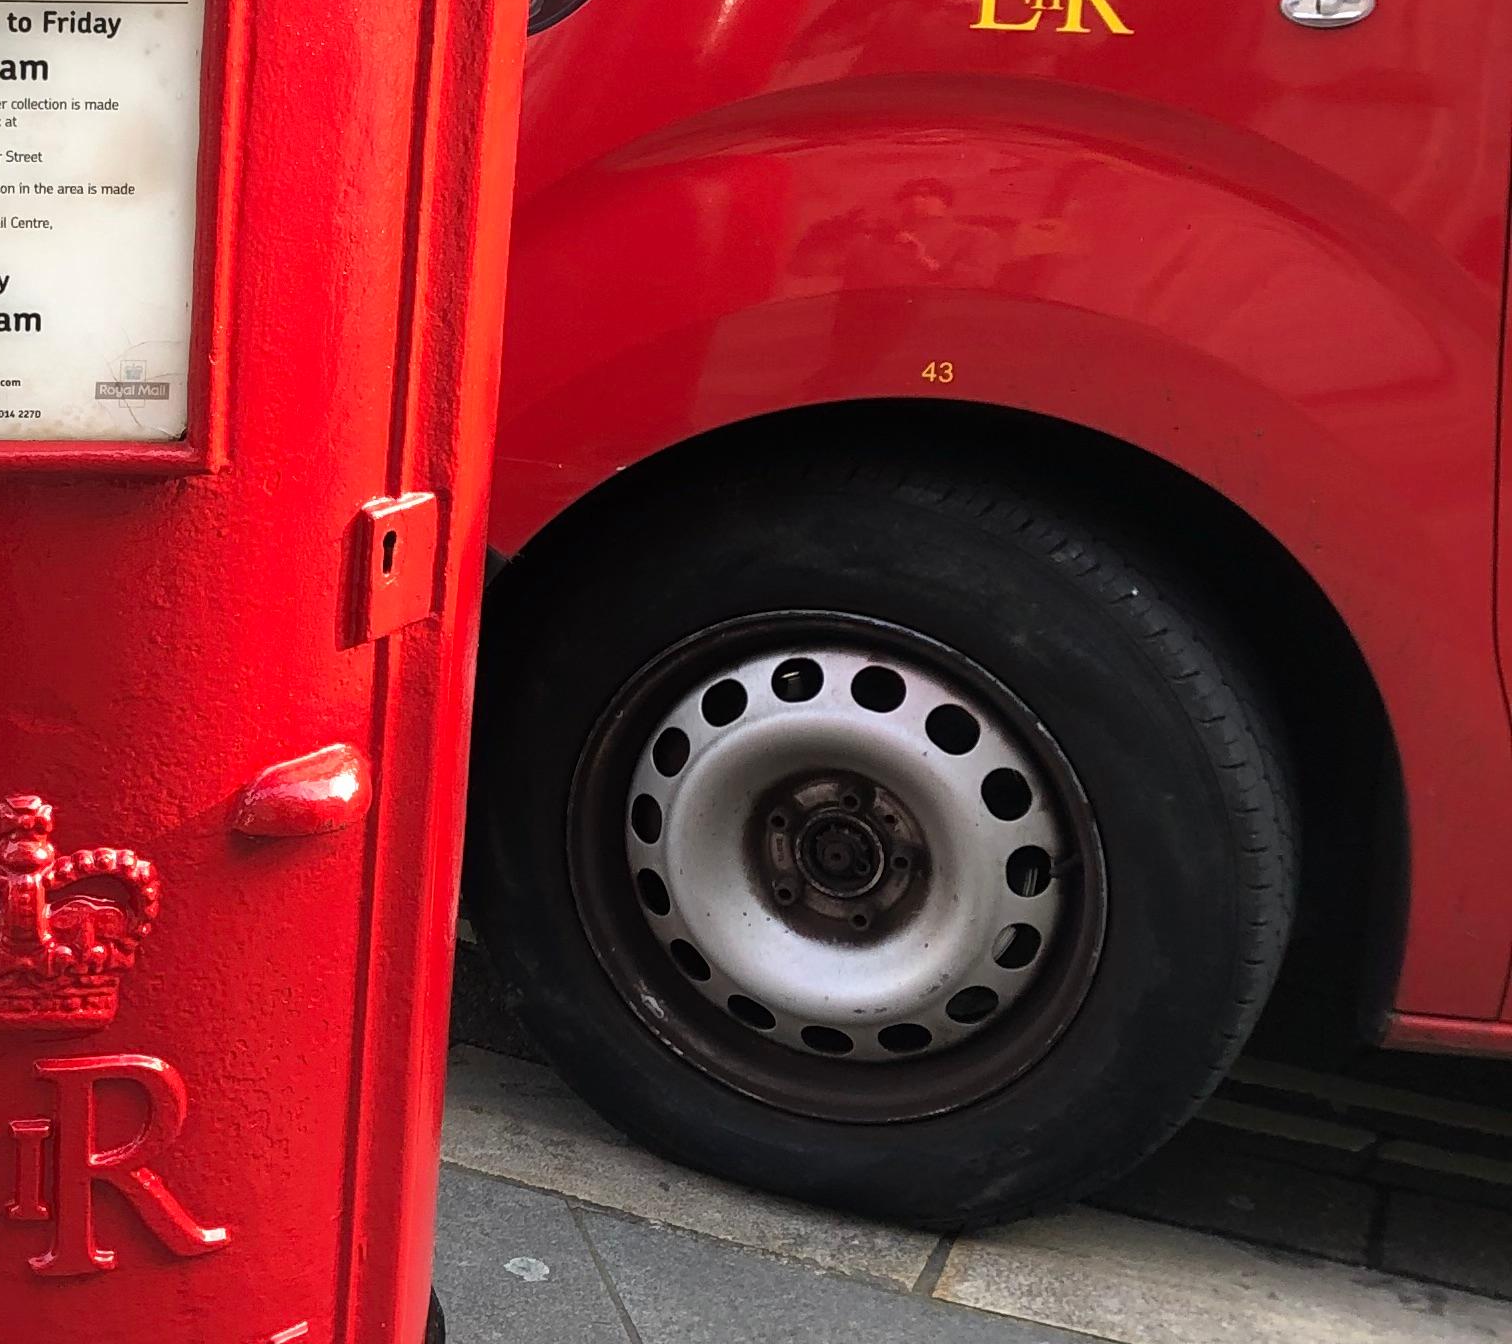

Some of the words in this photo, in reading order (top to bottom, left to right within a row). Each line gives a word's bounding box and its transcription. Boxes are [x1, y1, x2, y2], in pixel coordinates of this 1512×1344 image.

[6, 12, 32, 33] to
[42, 9, 122, 39] Friday
[10, 97, 68, 111] collection
[71, 97, 81, 111] is
[84, 97, 120, 111] made
[4, 116, 18, 128] at
[5, 149, 43, 163] Street
[18, 181, 31, 195] in
[33, 181, 54, 195] the
[56, 185, 84, 195] area
[87, 182, 98, 195] is
[100, 182, 136, 195] made
[10, 215, 53, 231] Centre,
[921, 361, 954, 383] 43
[99, 384, 135, 398] Royal
[137, 385, 166, 396] Mail
